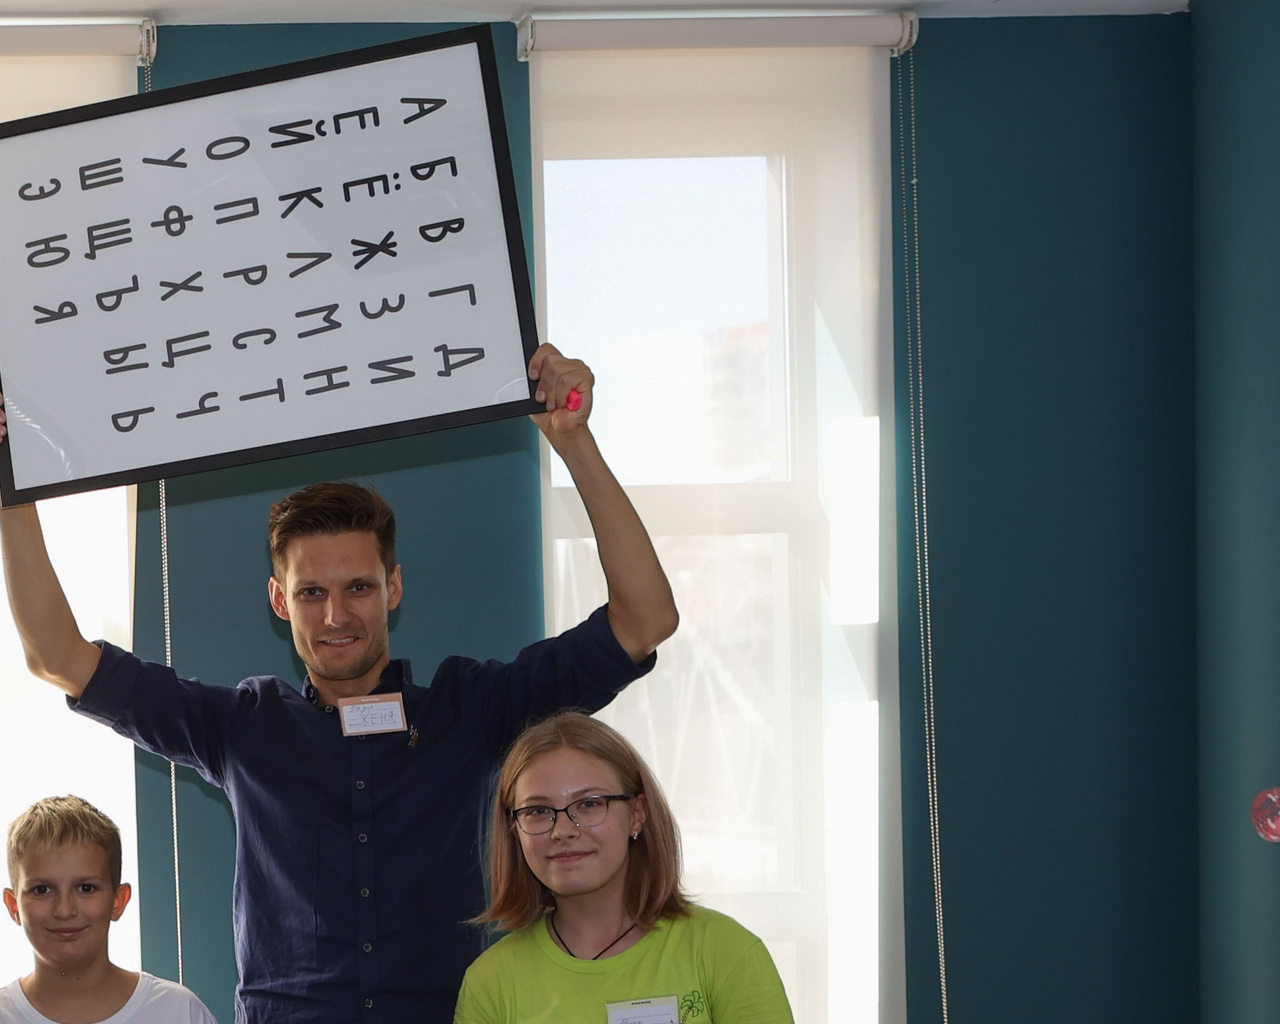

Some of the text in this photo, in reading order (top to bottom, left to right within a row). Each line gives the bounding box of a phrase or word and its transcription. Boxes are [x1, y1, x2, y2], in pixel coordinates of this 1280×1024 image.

[18, 178, 79, 325] Э Ю Я
[78, 157, 156, 433] Ш Щ Ъ Ы Ь
[141, 147, 221, 420] У Ф Х Ц Ч
[205, 135, 286, 403] О П Р С Т
[268, 118, 351, 396] Й К Л М Н
[332, 106, 416, 385] Е Ё Ж З И
[399, 97, 486, 378] А Б В Г Д
